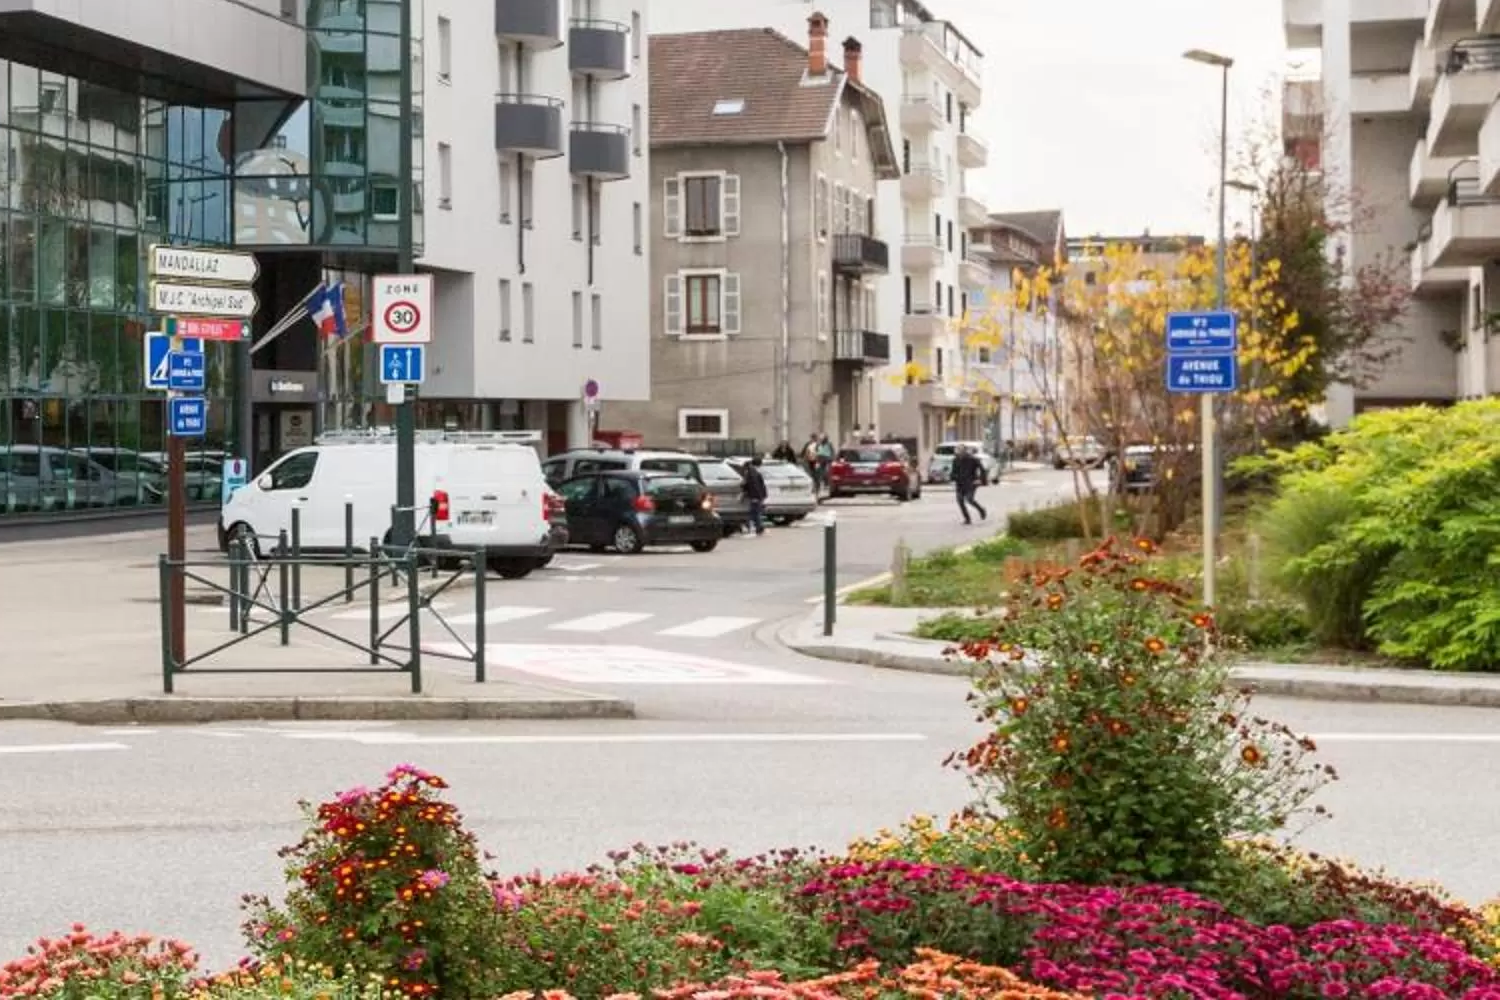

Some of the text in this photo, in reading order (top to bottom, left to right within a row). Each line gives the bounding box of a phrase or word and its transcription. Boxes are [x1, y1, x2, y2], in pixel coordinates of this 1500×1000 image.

[159, 254, 219, 273] MANDALLAZ
[386, 284, 418, 294] ZONE
[392, 309, 414, 325] 30
[1182, 359, 1220, 371] AVENUE
